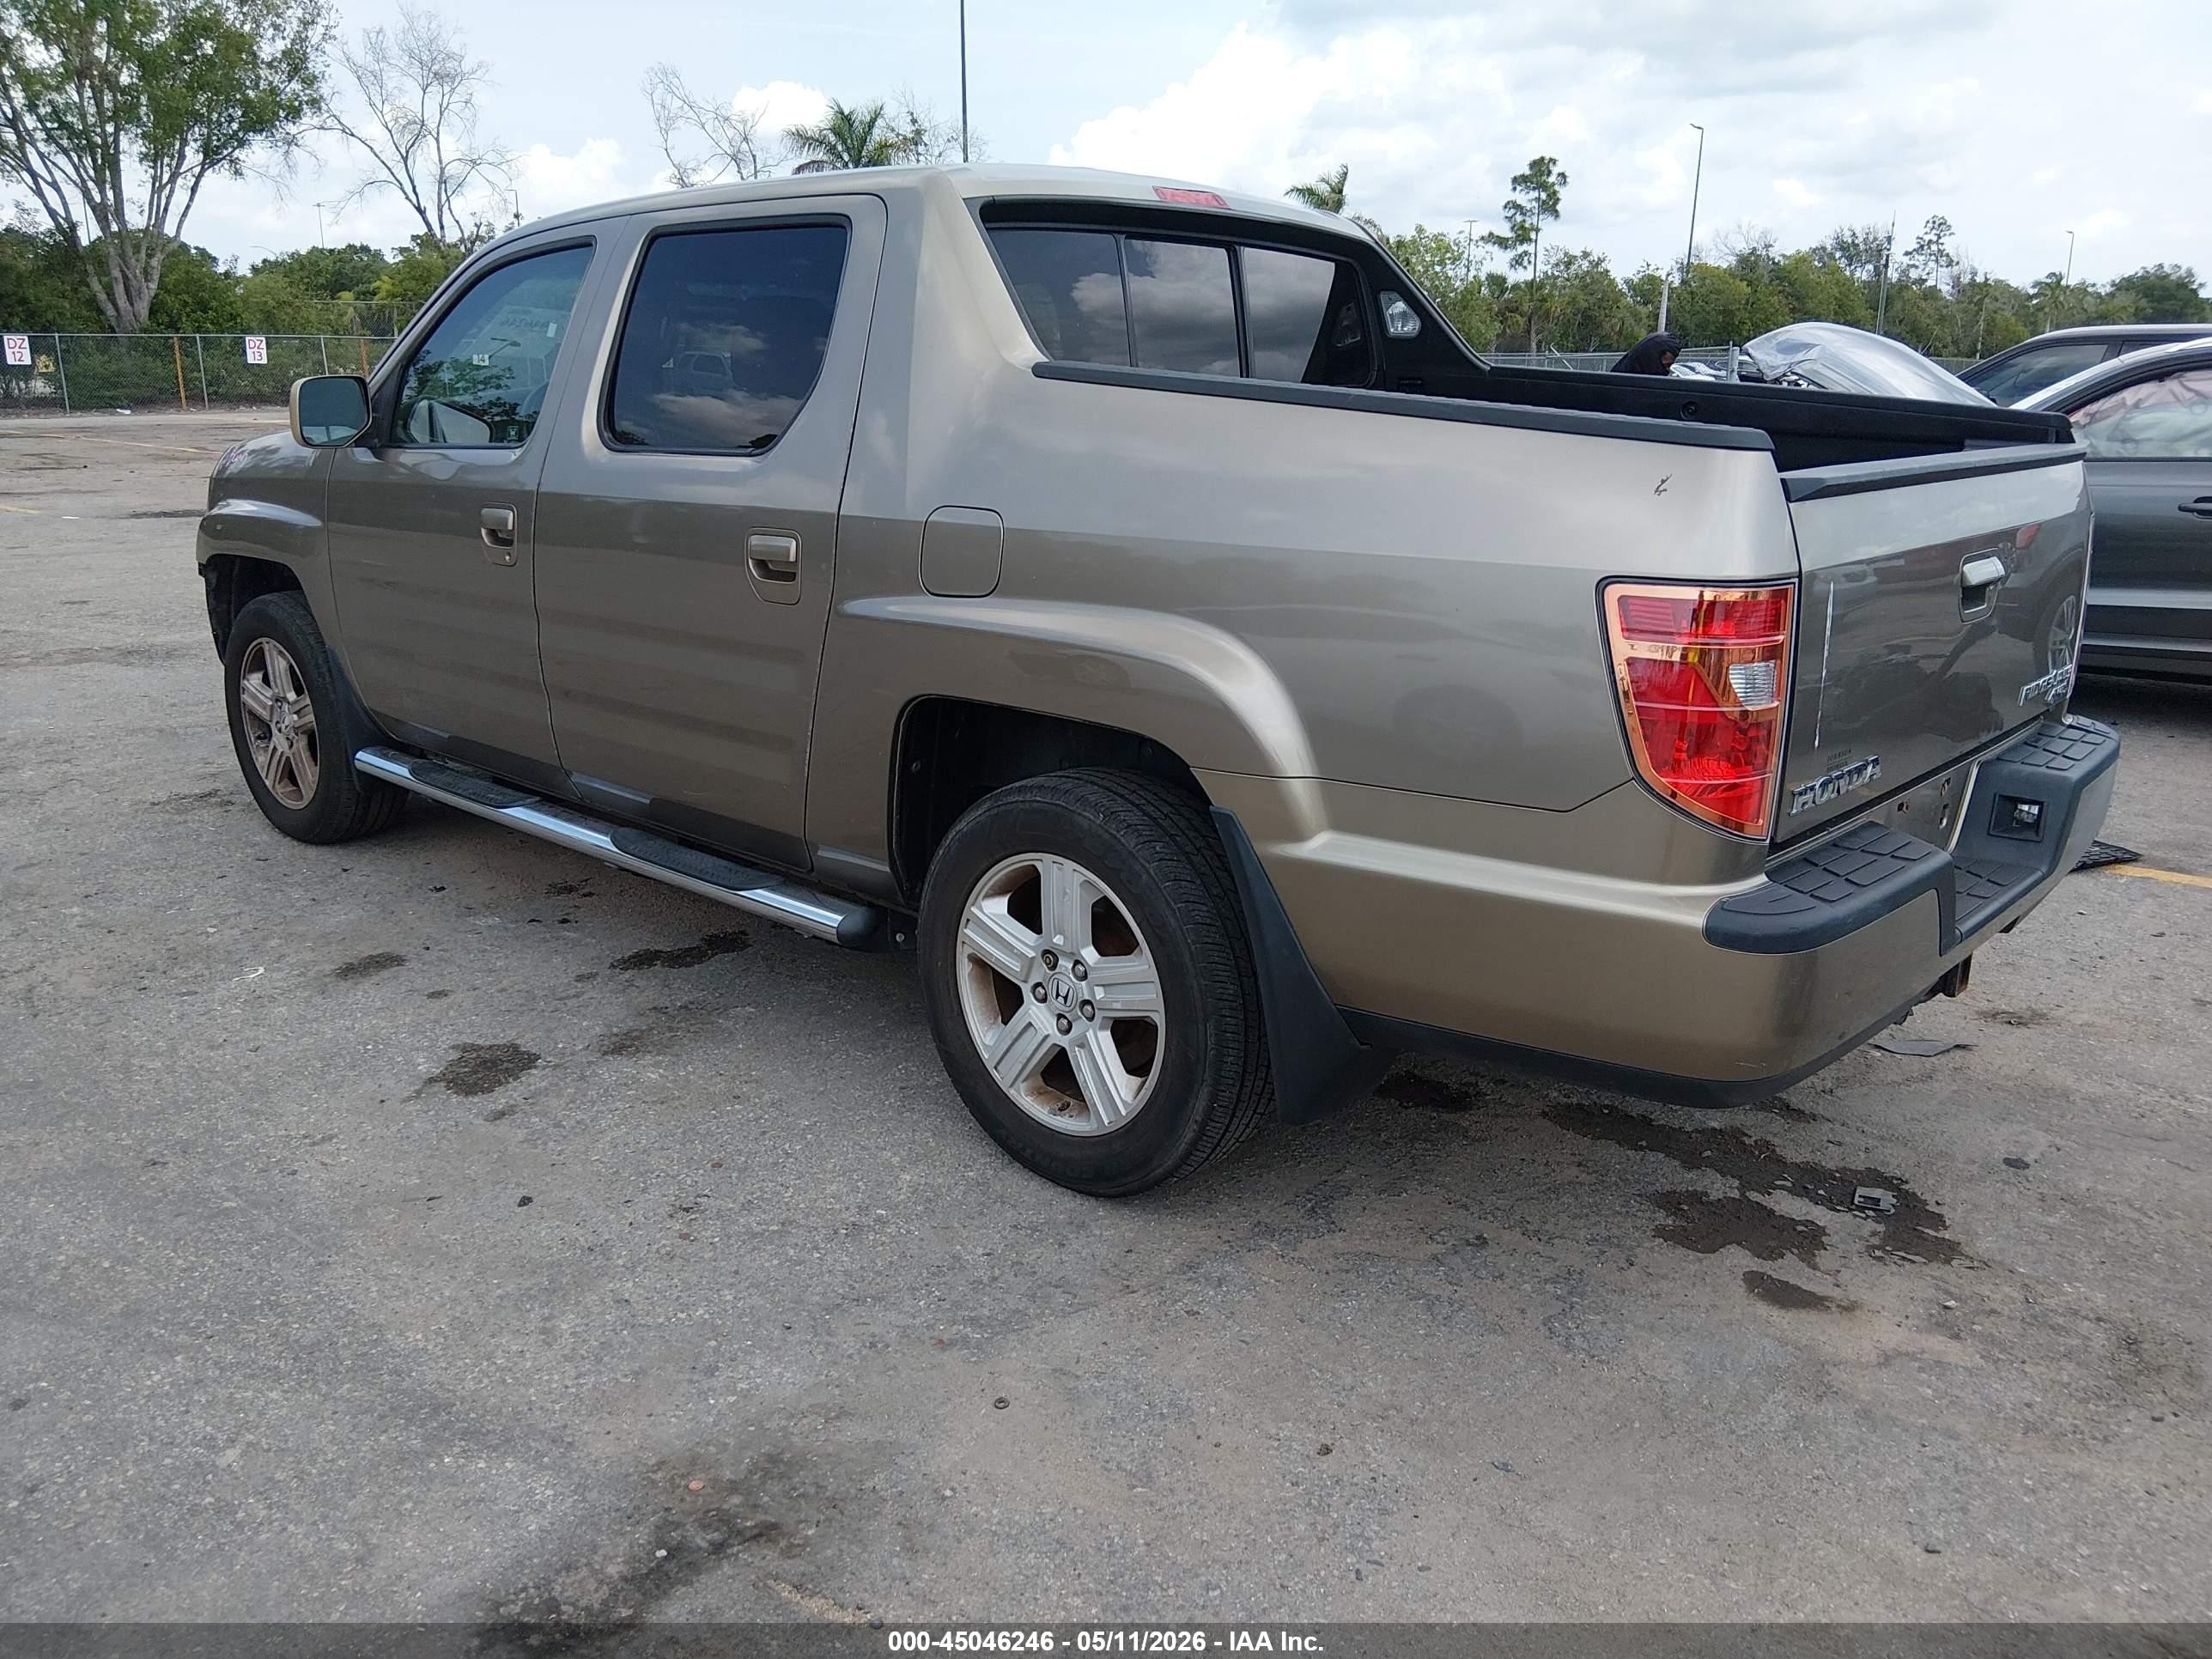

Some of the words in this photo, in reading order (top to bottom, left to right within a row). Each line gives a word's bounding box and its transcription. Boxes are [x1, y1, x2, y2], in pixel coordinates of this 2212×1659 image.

[7, 337, 27, 349] DZ
[248, 339, 264, 349] DZ
[12, 351, 25, 362] 12
[252, 351, 263, 361] 13
[1790, 755, 1882, 816] HONDA
